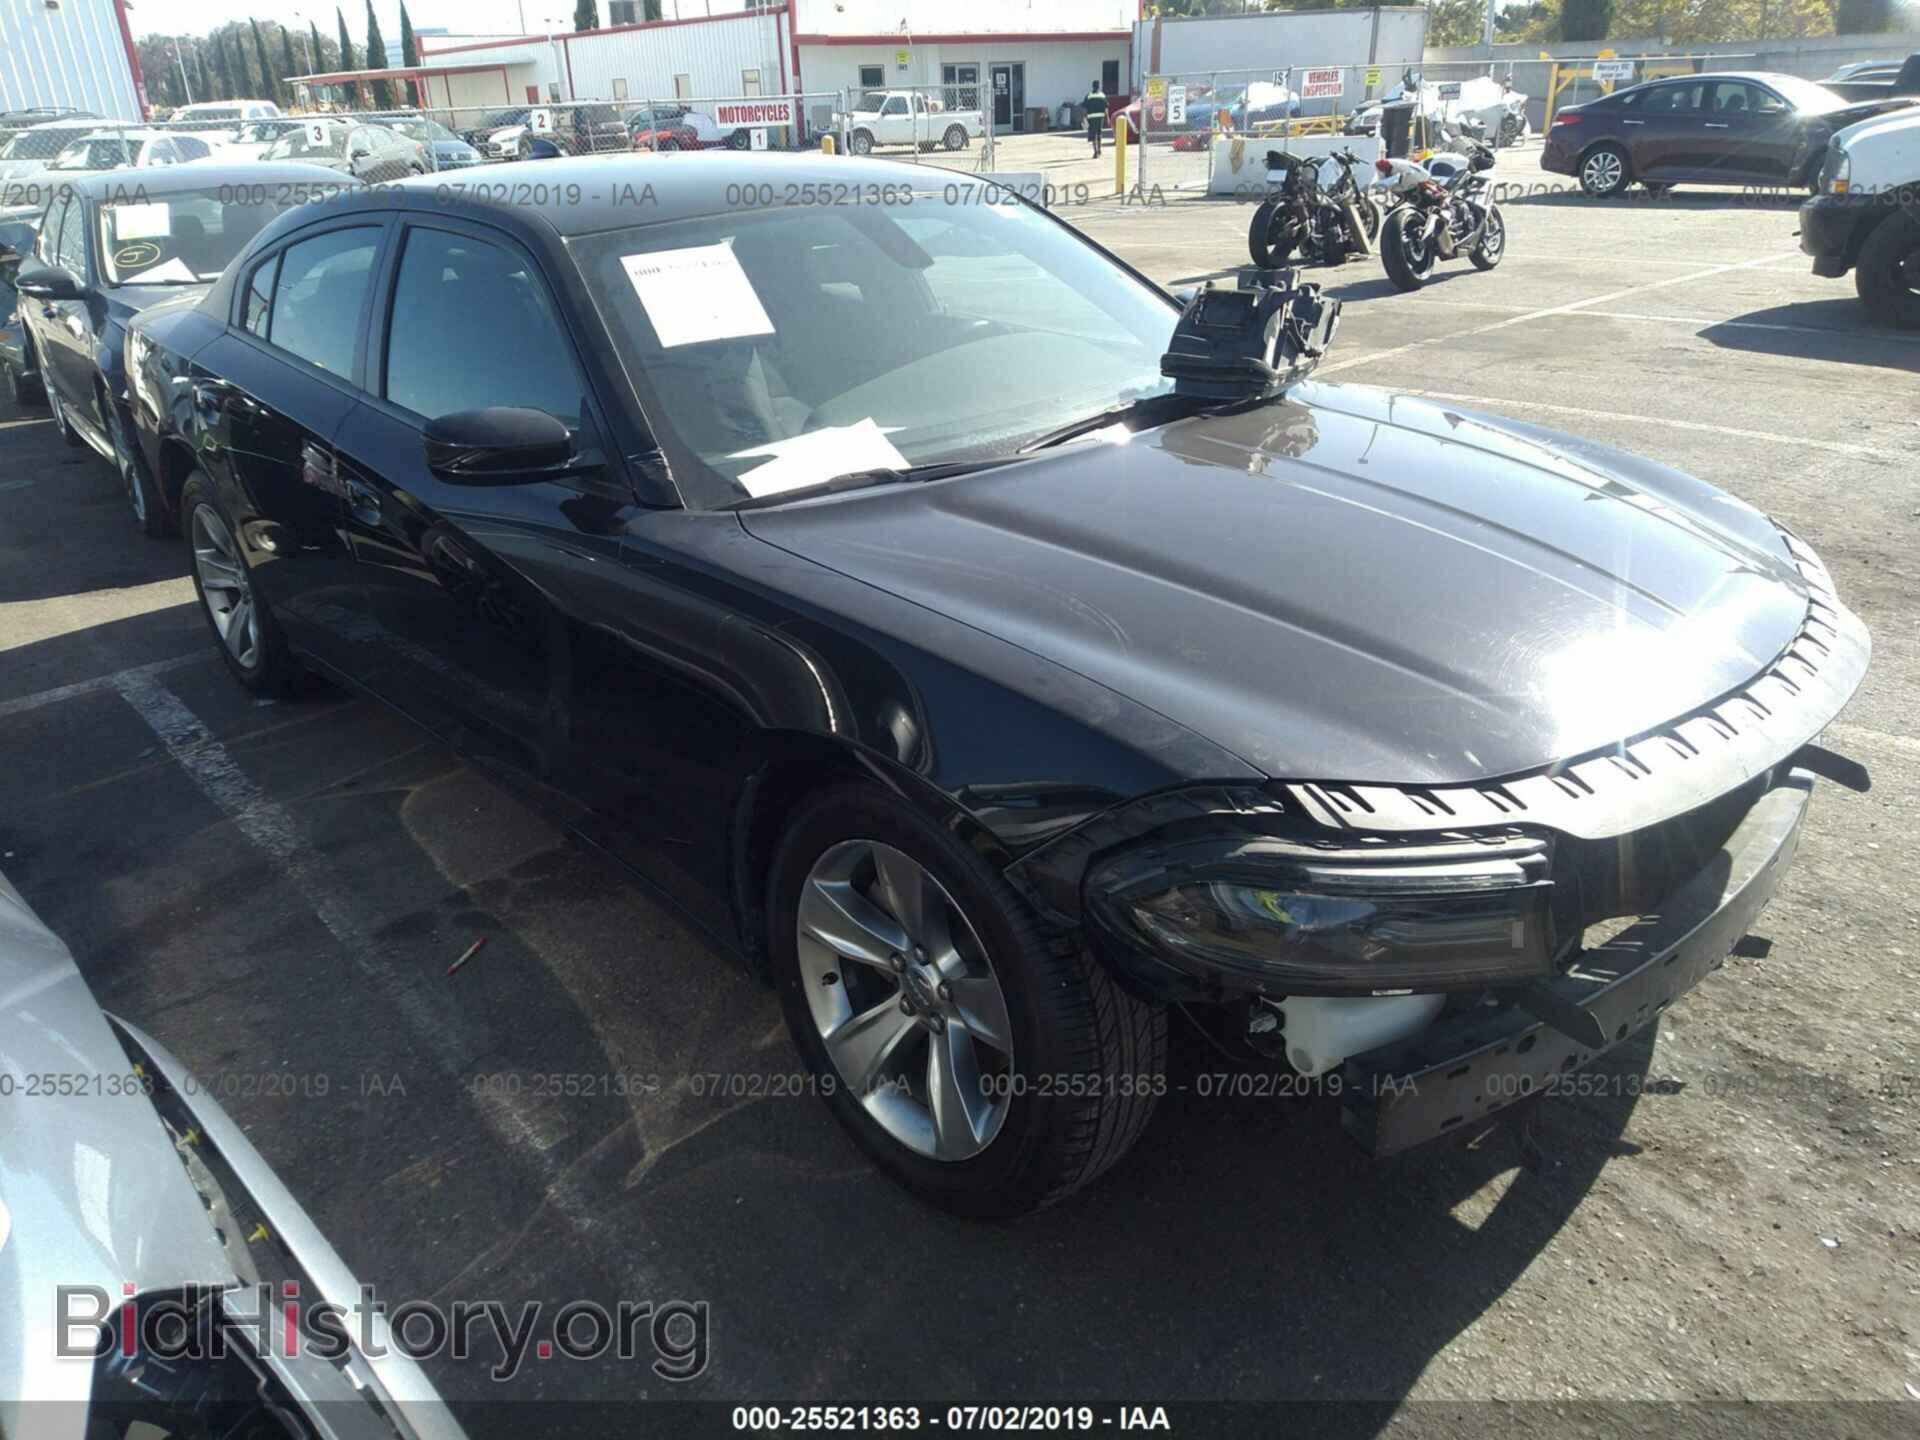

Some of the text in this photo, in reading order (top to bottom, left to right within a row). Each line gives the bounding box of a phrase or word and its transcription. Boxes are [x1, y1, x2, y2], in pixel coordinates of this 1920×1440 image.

[1308, 70, 1339, 83] VEHICLES
[718, 104, 790, 124] MOTORCYCLES
[1173, 105, 1181, 120] 5
[537, 113, 546, 128] 2
[313, 126, 323, 142] 3
[757, 133, 763, 146] 1
